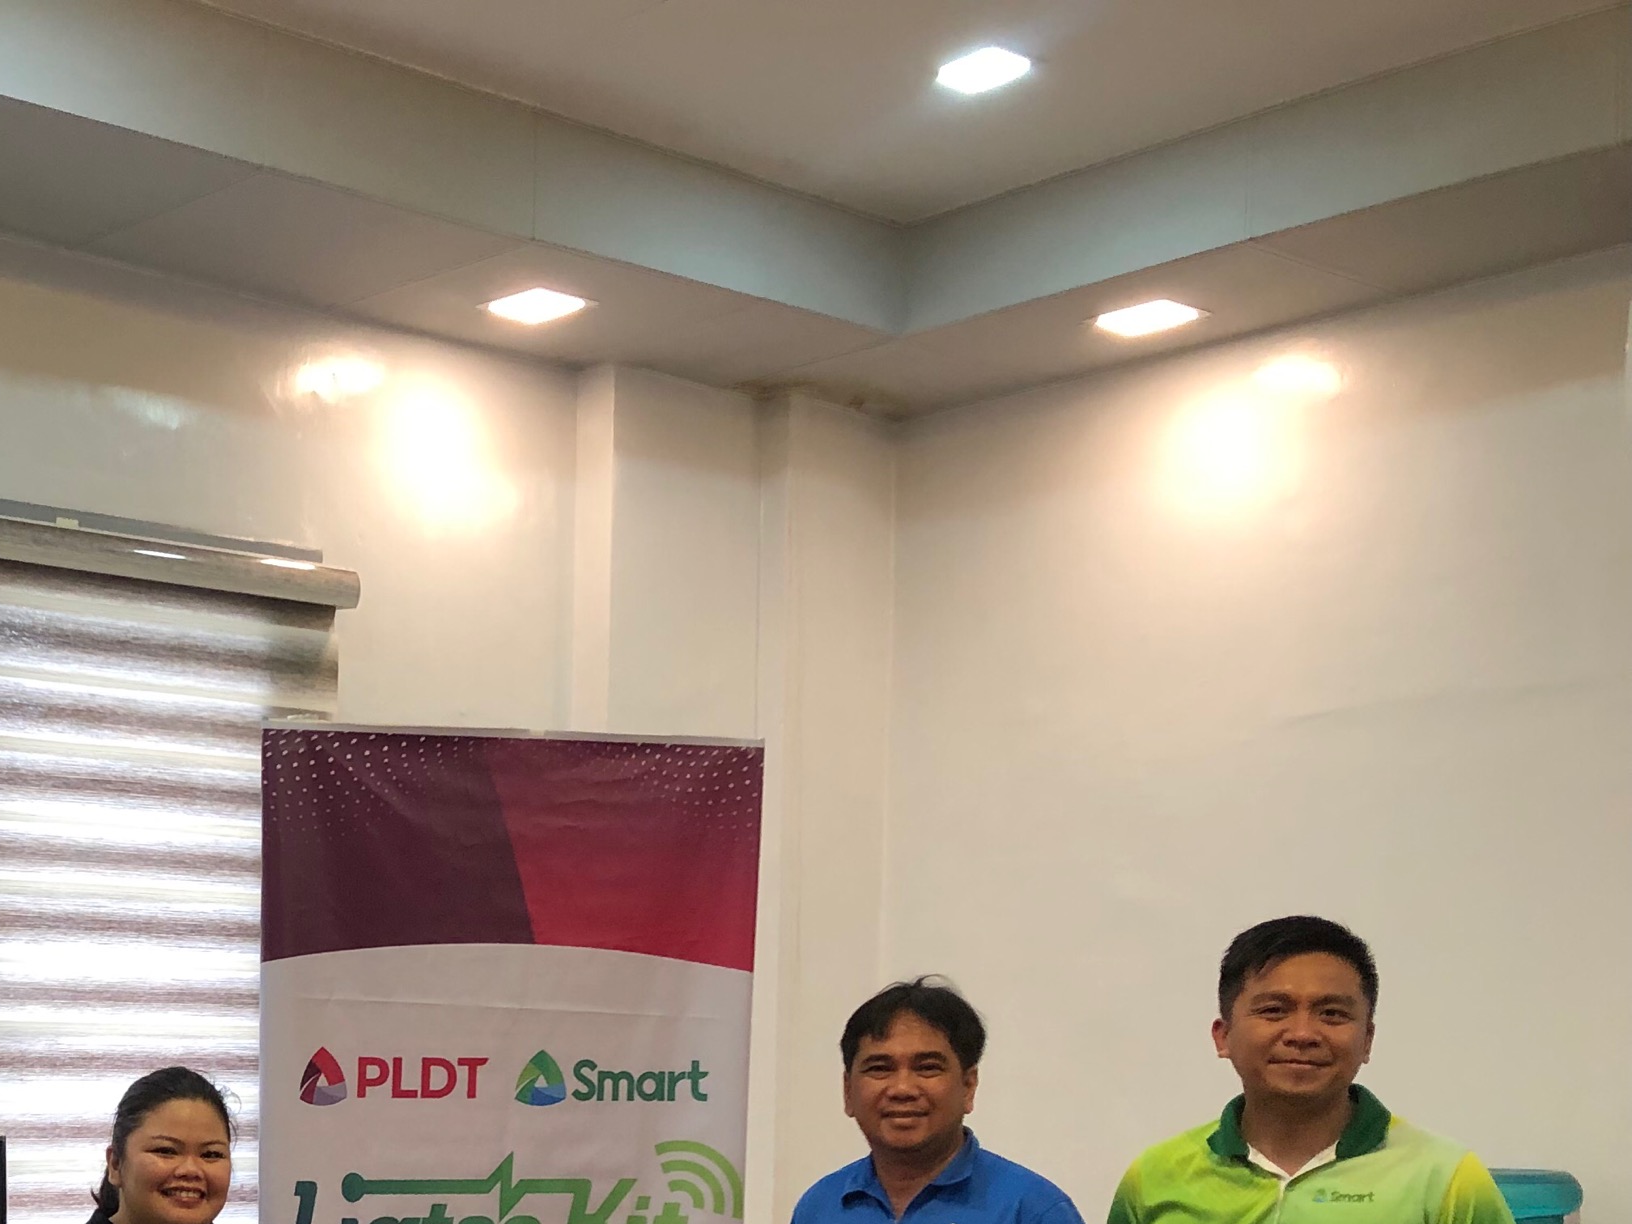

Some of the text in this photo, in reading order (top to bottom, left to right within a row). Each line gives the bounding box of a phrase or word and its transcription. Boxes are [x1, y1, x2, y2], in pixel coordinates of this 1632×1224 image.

[357, 1057, 709, 1102] PLDT Smart
[1329, 1190, 1375, 1202] Smart
